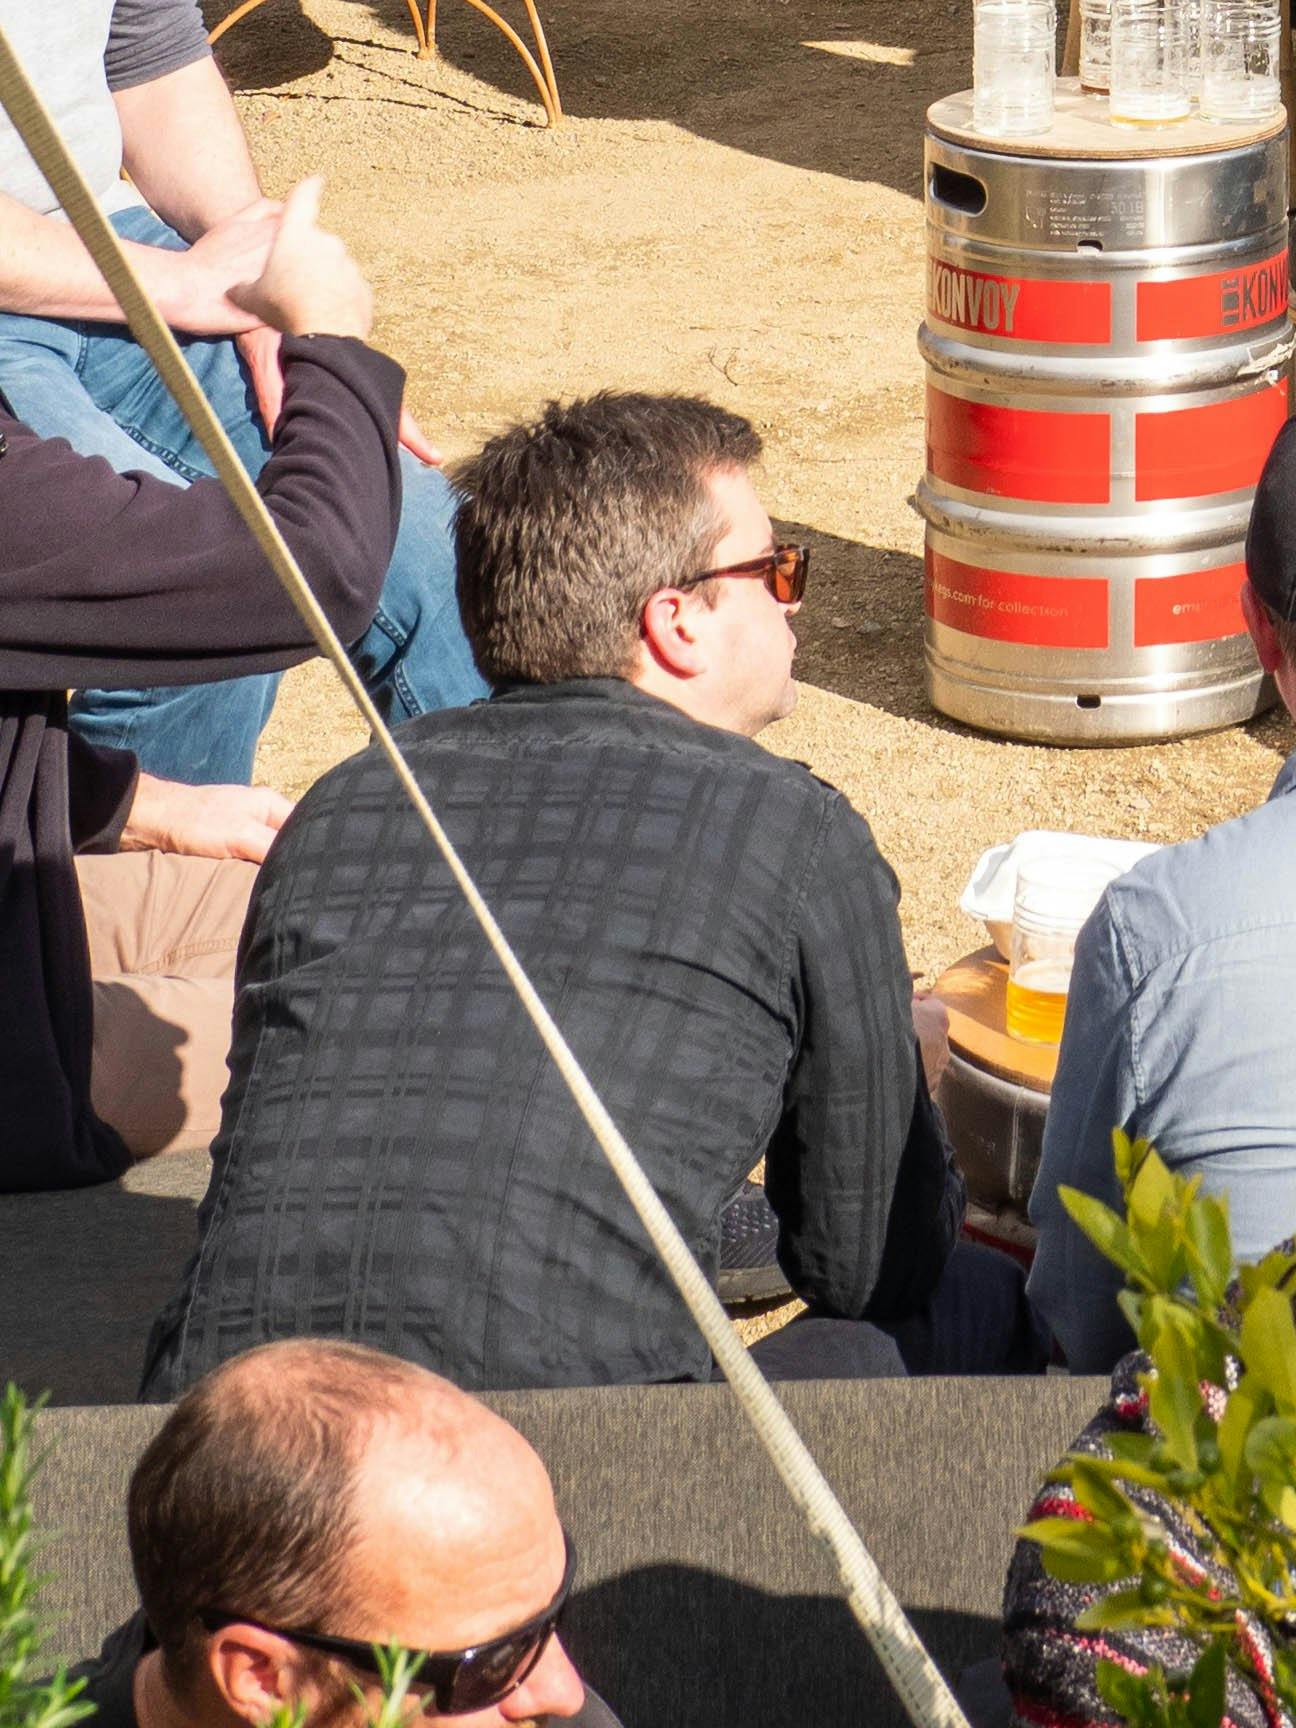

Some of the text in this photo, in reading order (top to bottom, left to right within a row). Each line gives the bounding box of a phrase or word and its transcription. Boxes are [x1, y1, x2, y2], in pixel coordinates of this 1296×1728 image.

[932, 263, 1020, 332] KONVOY
[977, 592, 995, 609] for
[997, 599, 1069, 618] collection
